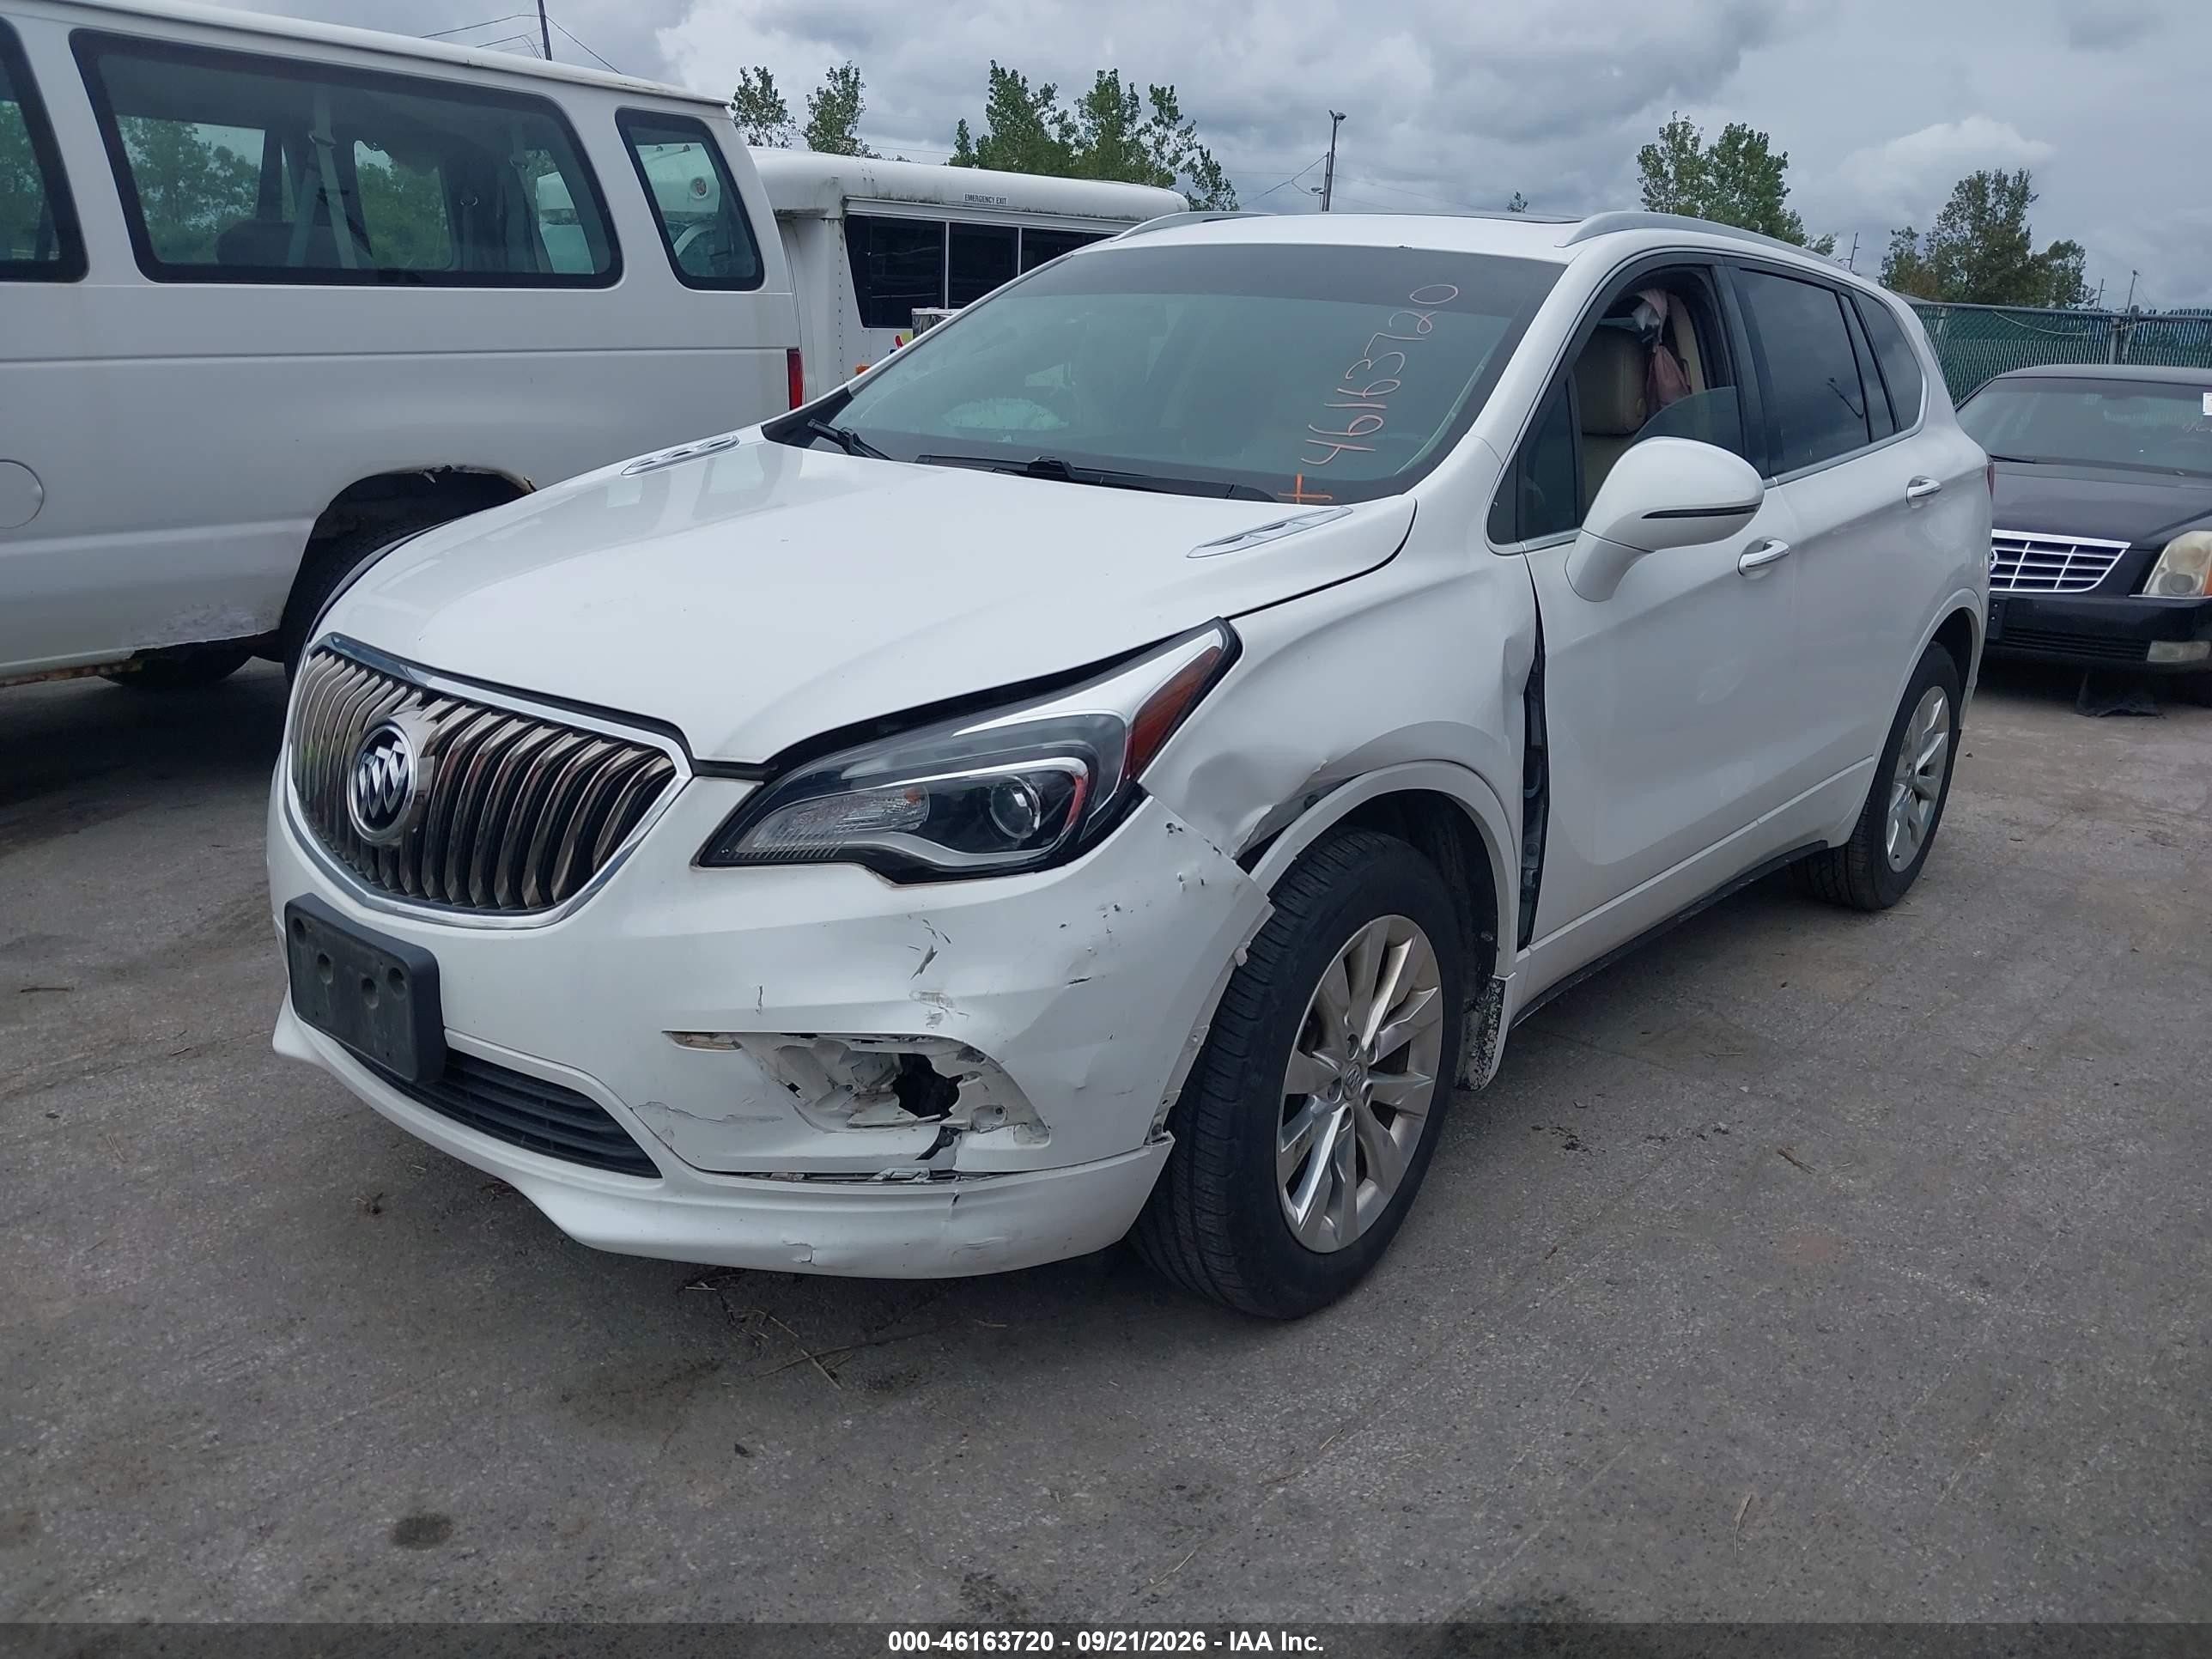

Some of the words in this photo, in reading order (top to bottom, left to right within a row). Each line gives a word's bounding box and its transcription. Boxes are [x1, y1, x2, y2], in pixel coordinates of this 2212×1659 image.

[964, 193, 994, 204] EMERGENCY
[996, 197, 1007, 205] EXIT
[1300, 283, 1459, 465] 46163720
